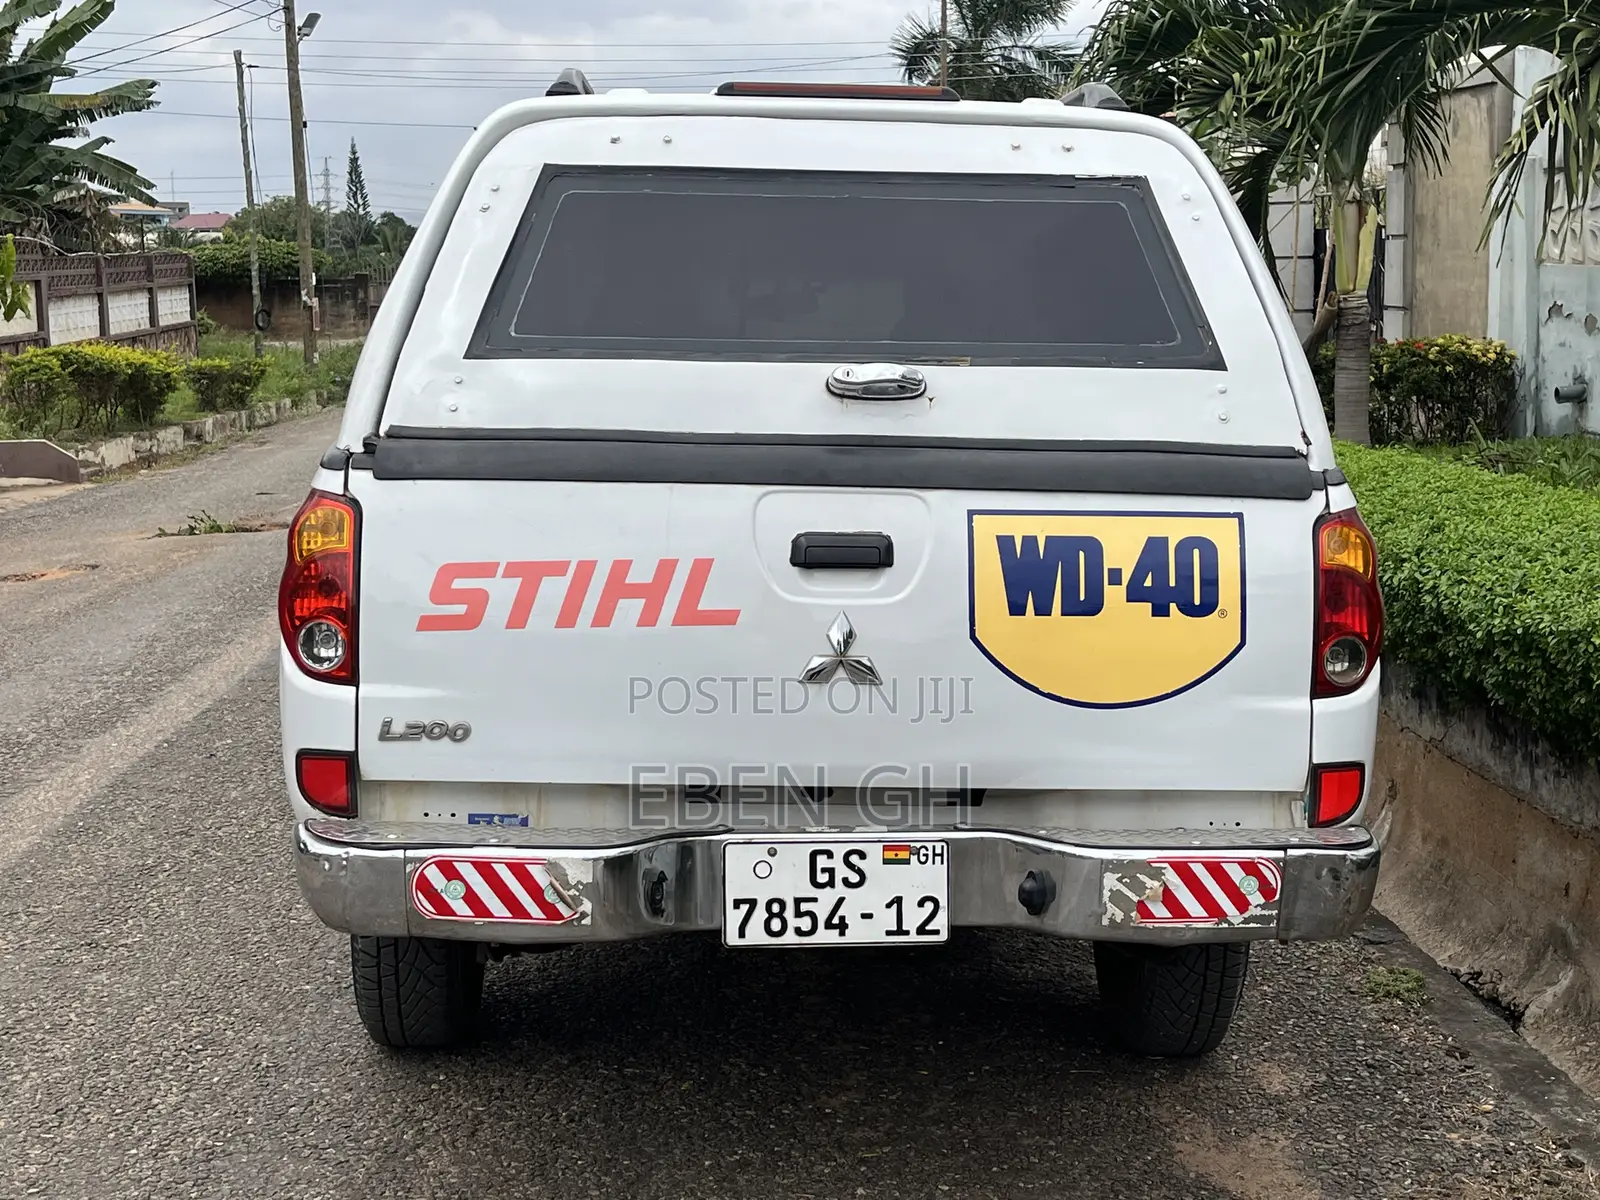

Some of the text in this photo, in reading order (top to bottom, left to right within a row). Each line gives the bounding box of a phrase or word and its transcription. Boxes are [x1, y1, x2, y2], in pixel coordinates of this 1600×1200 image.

[415, 557, 742, 632] STIHL
[995, 534, 1220, 618] WD-40
[377, 716, 472, 743] L200
[808, 848, 868, 890] GS
[916, 844, 945, 866] GH
[732, 895, 942, 939] 7854-12
